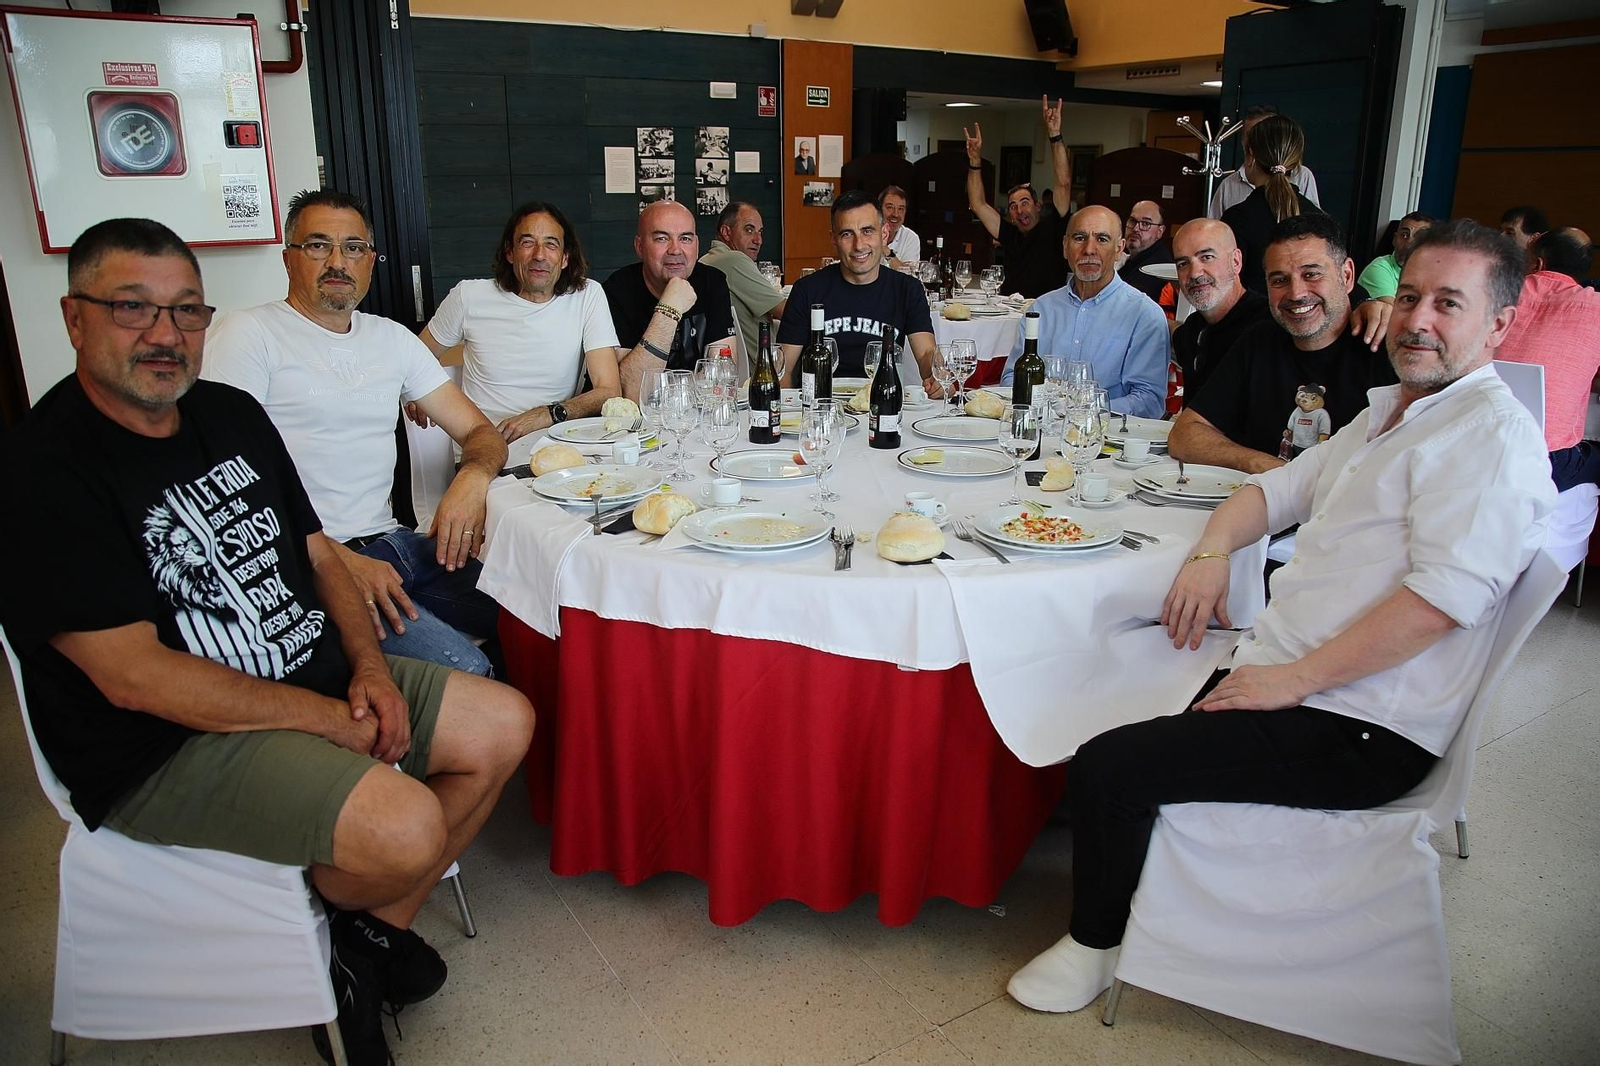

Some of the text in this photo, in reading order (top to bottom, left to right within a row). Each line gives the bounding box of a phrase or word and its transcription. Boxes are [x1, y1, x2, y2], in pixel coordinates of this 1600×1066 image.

[808, 89, 828, 98] SALIDA
[824, 316, 852, 336] EPE
[354, 919, 390, 949] FILA
